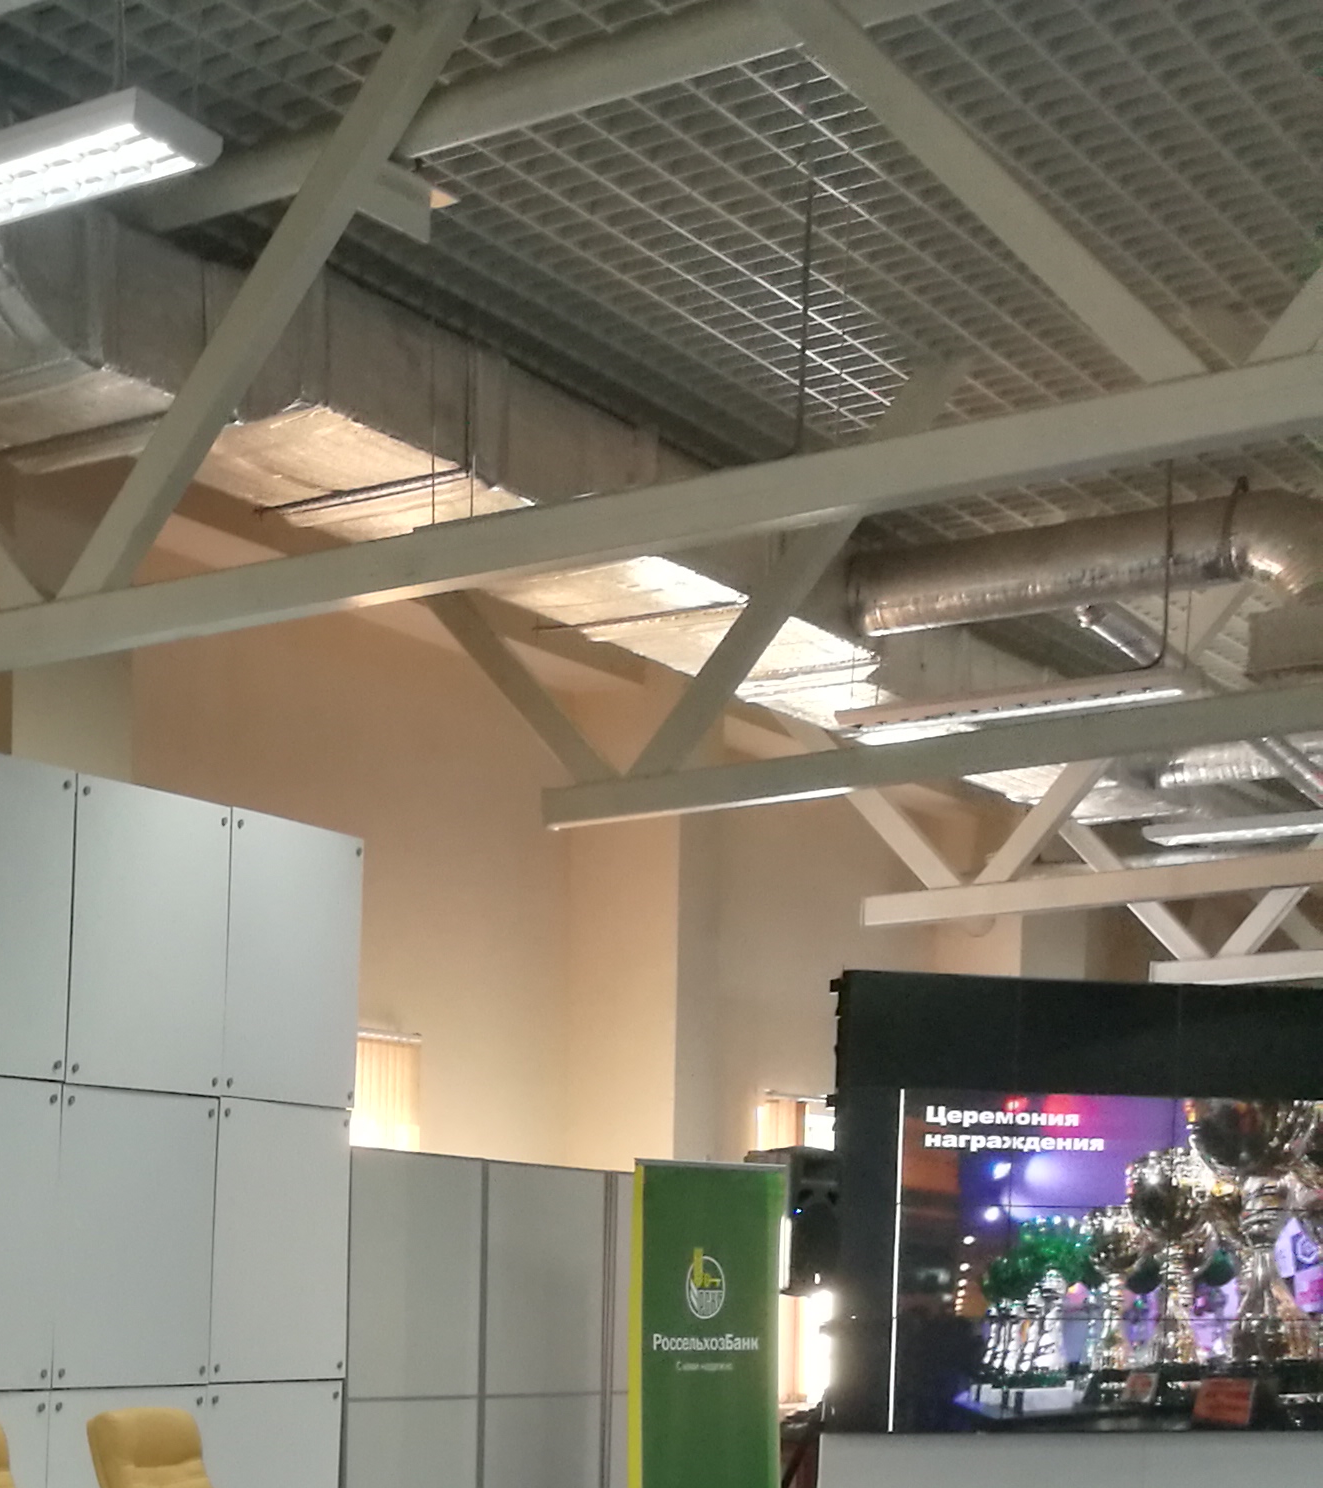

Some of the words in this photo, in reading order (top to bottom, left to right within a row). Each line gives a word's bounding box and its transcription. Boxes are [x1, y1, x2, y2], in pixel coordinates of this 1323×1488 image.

[925, 1105, 1081, 1127] Церемония
[924, 1132, 1106, 1152] награждения
[652, 1333, 759, 1351] РоссельхозБанк
